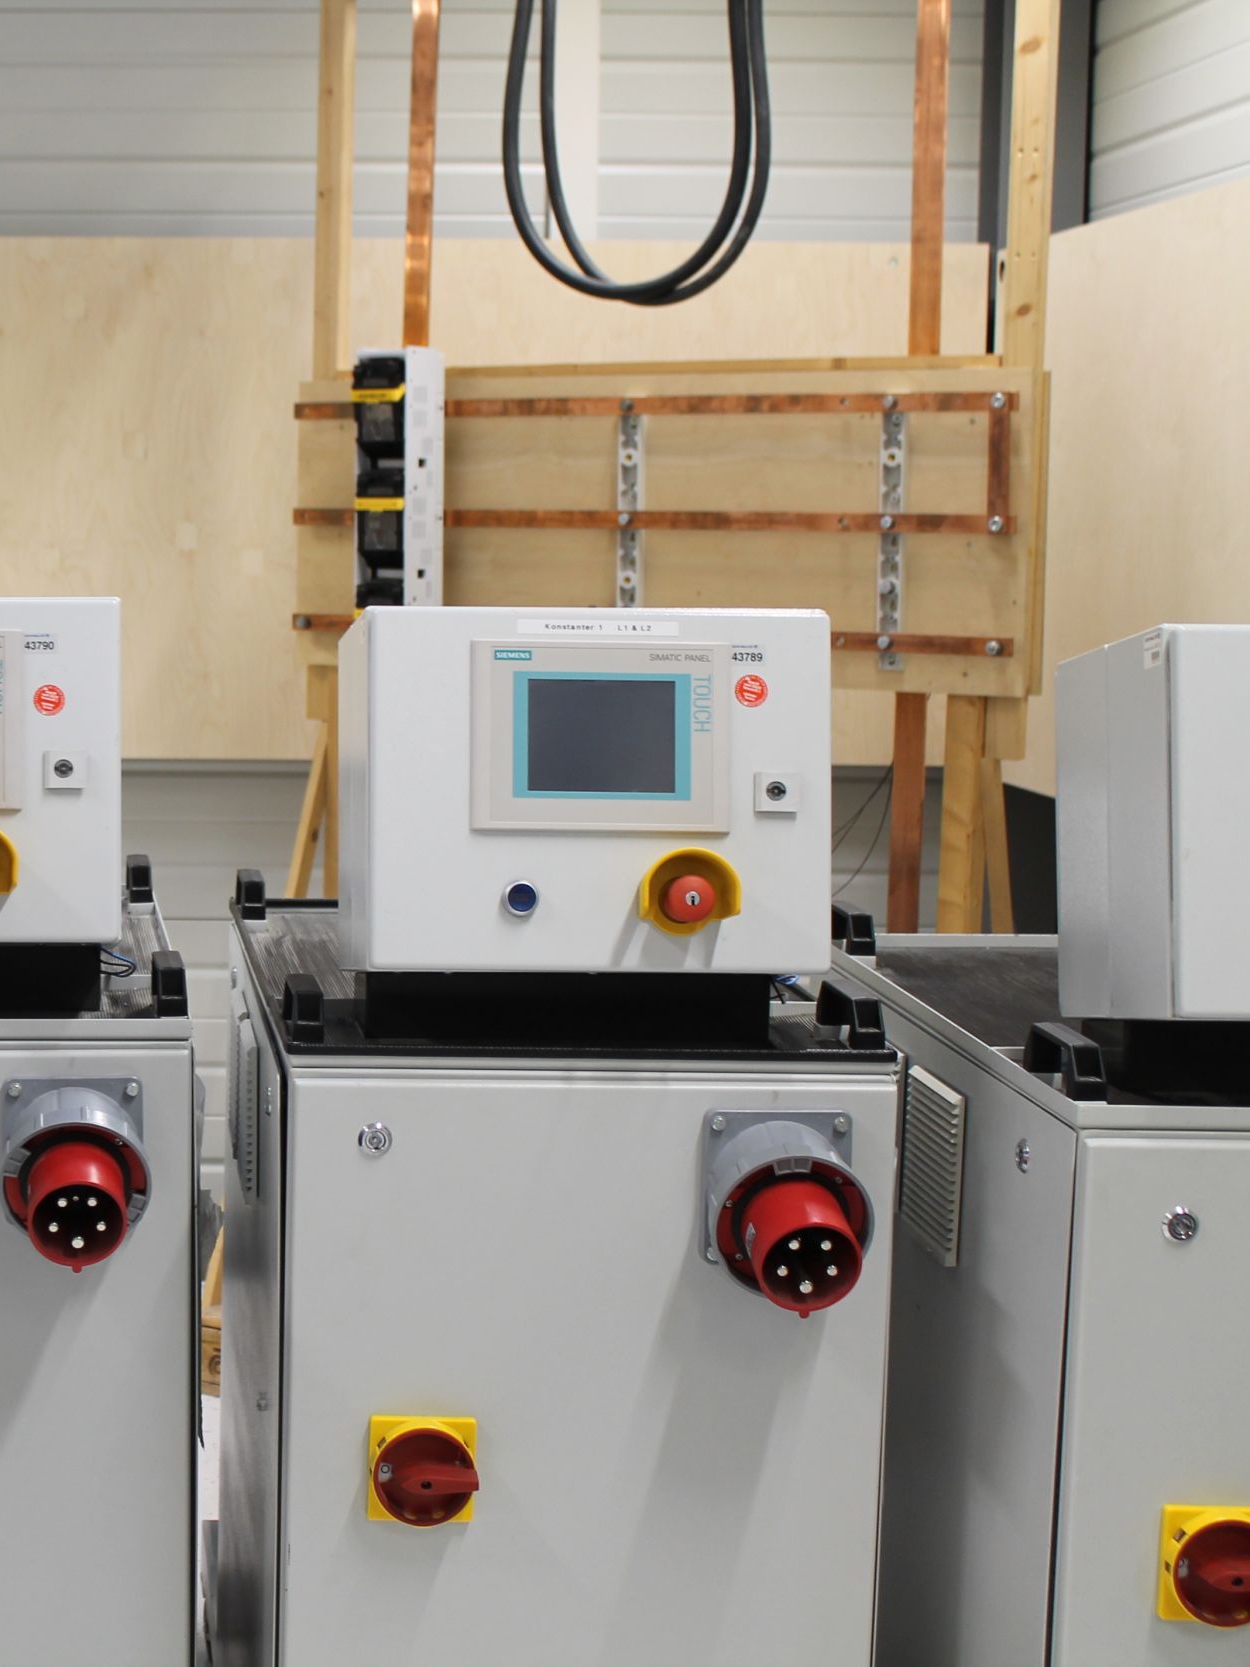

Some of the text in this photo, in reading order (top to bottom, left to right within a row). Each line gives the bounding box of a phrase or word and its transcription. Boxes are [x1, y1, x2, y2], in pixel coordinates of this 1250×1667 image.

[544, 623, 594, 631] Konstanter
[24, 641, 55, 651] 43790
[495, 651, 531, 659] SIEMENS
[649, 653, 711, 663] SIMATIC PANEL
[732, 652, 763, 663] 43789
[693, 674, 711, 733] TOUCH
